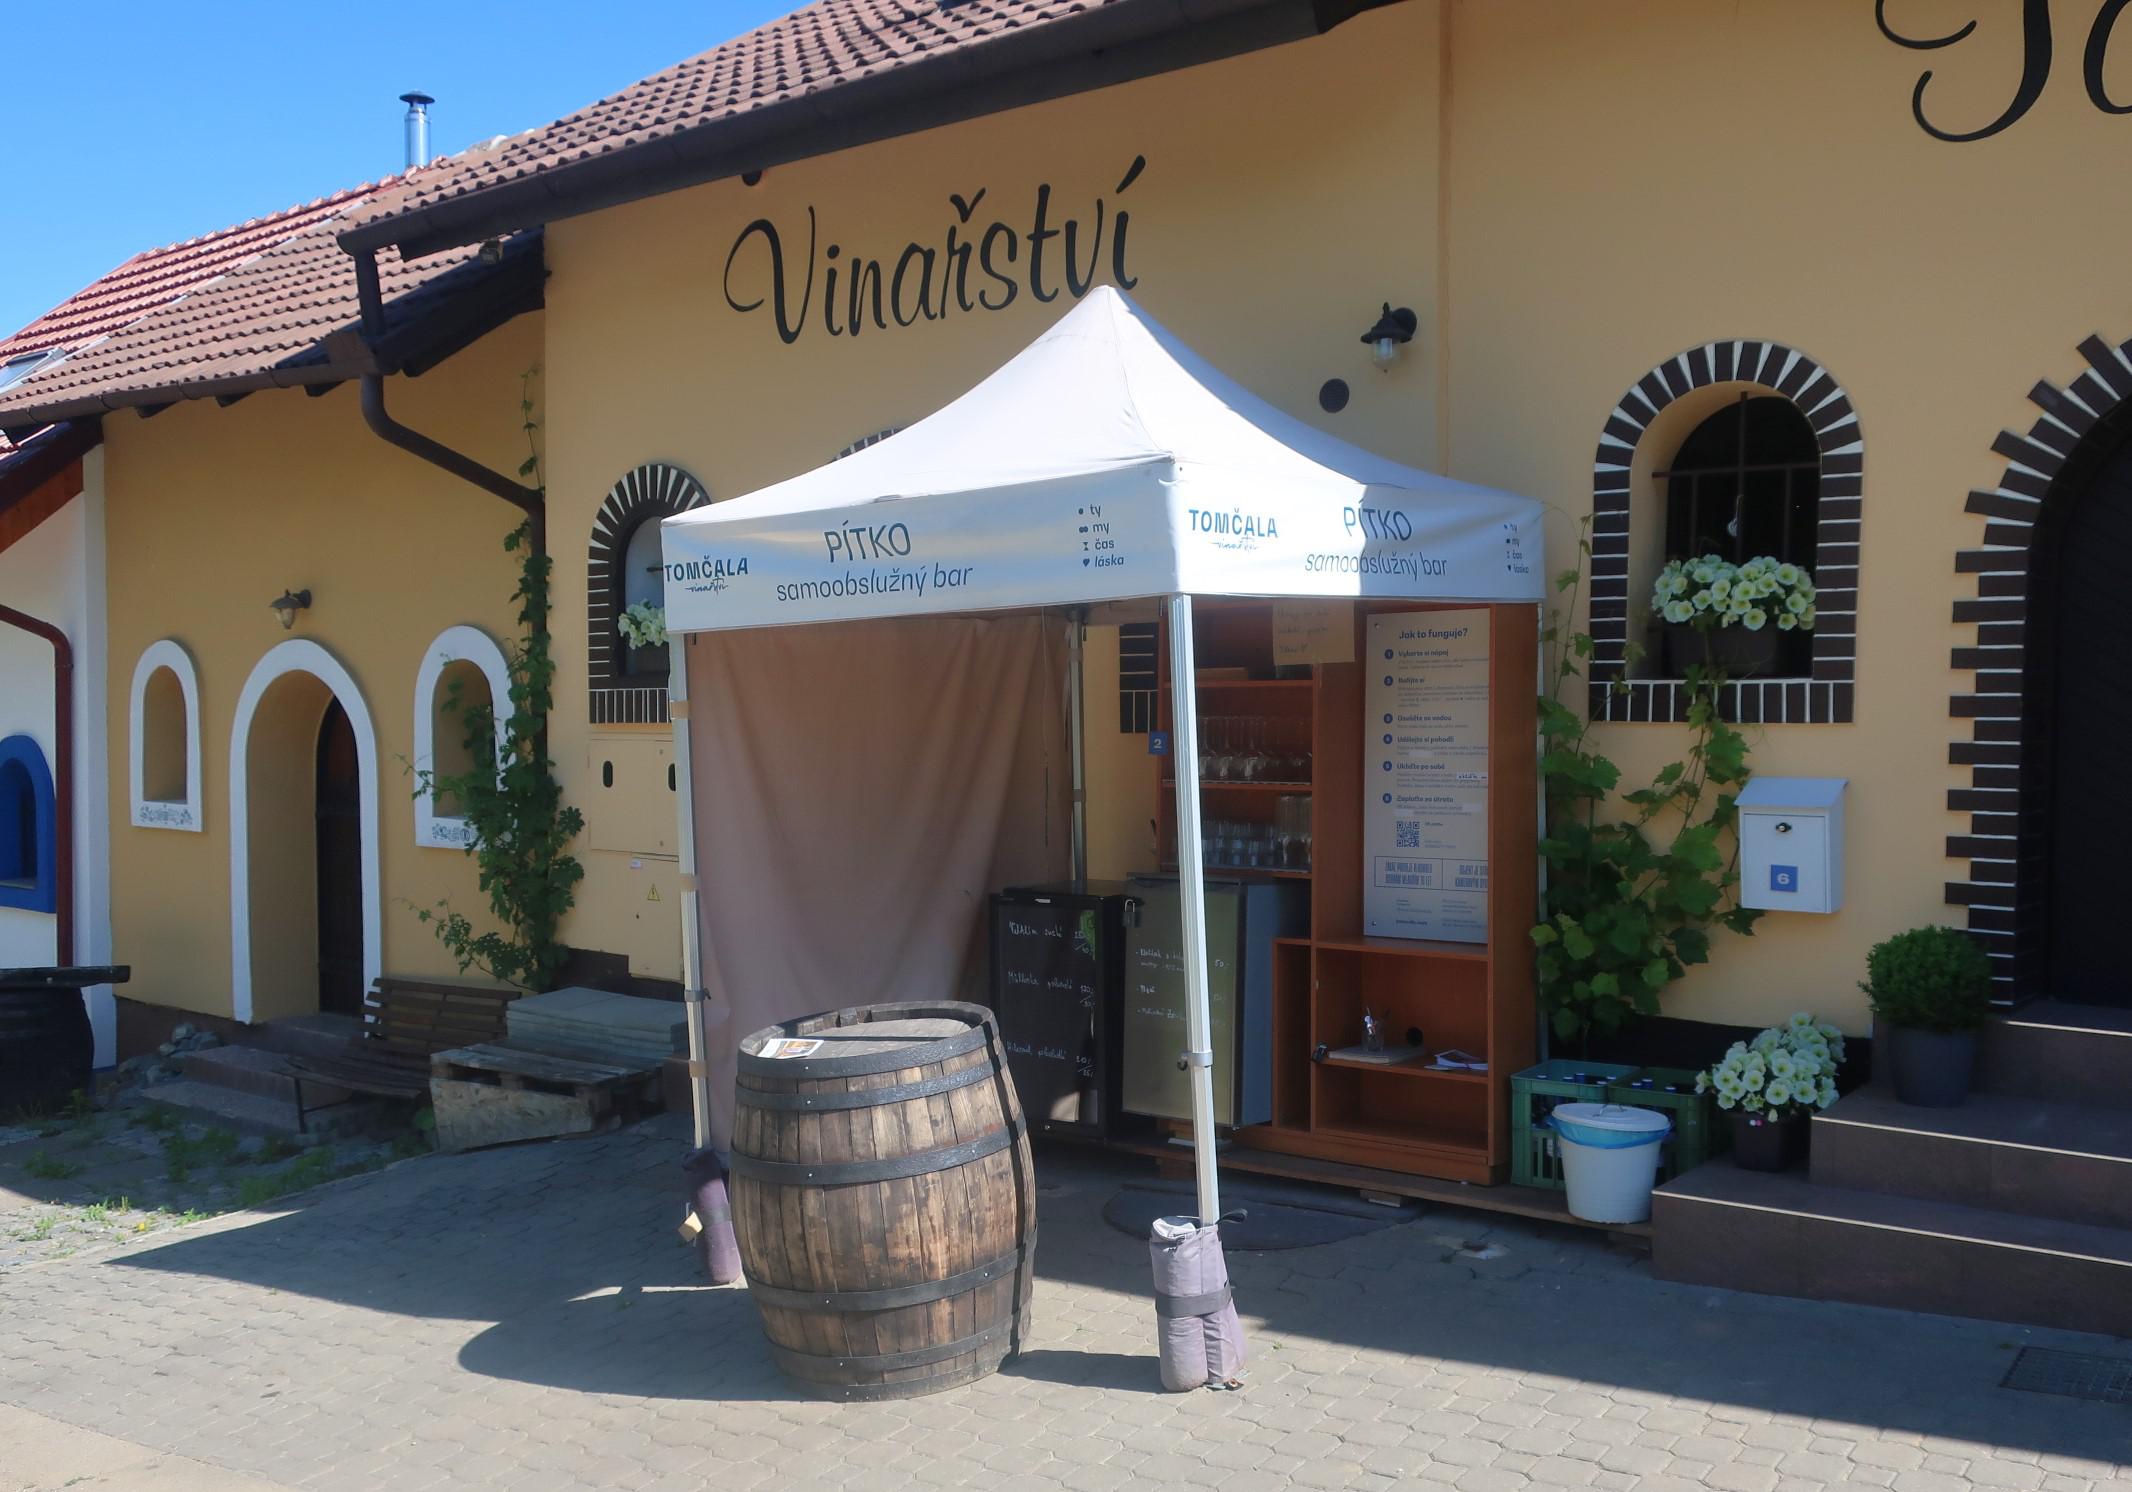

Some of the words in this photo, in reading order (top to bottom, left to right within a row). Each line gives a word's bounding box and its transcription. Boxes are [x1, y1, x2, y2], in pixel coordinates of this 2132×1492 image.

[724, 155, 1146, 344] Vinařství
[1090, 503, 1101, 518] ty
[1343, 498, 1412, 542] PÍTKO
[1092, 522, 1110, 535] my
[1189, 507, 1278, 538] TOMČALA
[824, 519, 911, 563] PÍTKO
[1095, 537, 1115, 550] čas
[664, 554, 748, 582] TOMČALA
[1095, 553, 1124, 568] láska
[1304, 549, 1420, 581] samoobslužný
[1422, 553, 1447, 577] bar
[776, 564, 928, 602] samoobslužný
[932, 562, 974, 588] bar
[1399, 630, 1415, 640] Jak
[1417, 630, 1427, 639] to
[1428, 627, 1468, 640] funguje?
[1153, 738, 1162, 749] 2
[1776, 872, 1790, 885] 6
